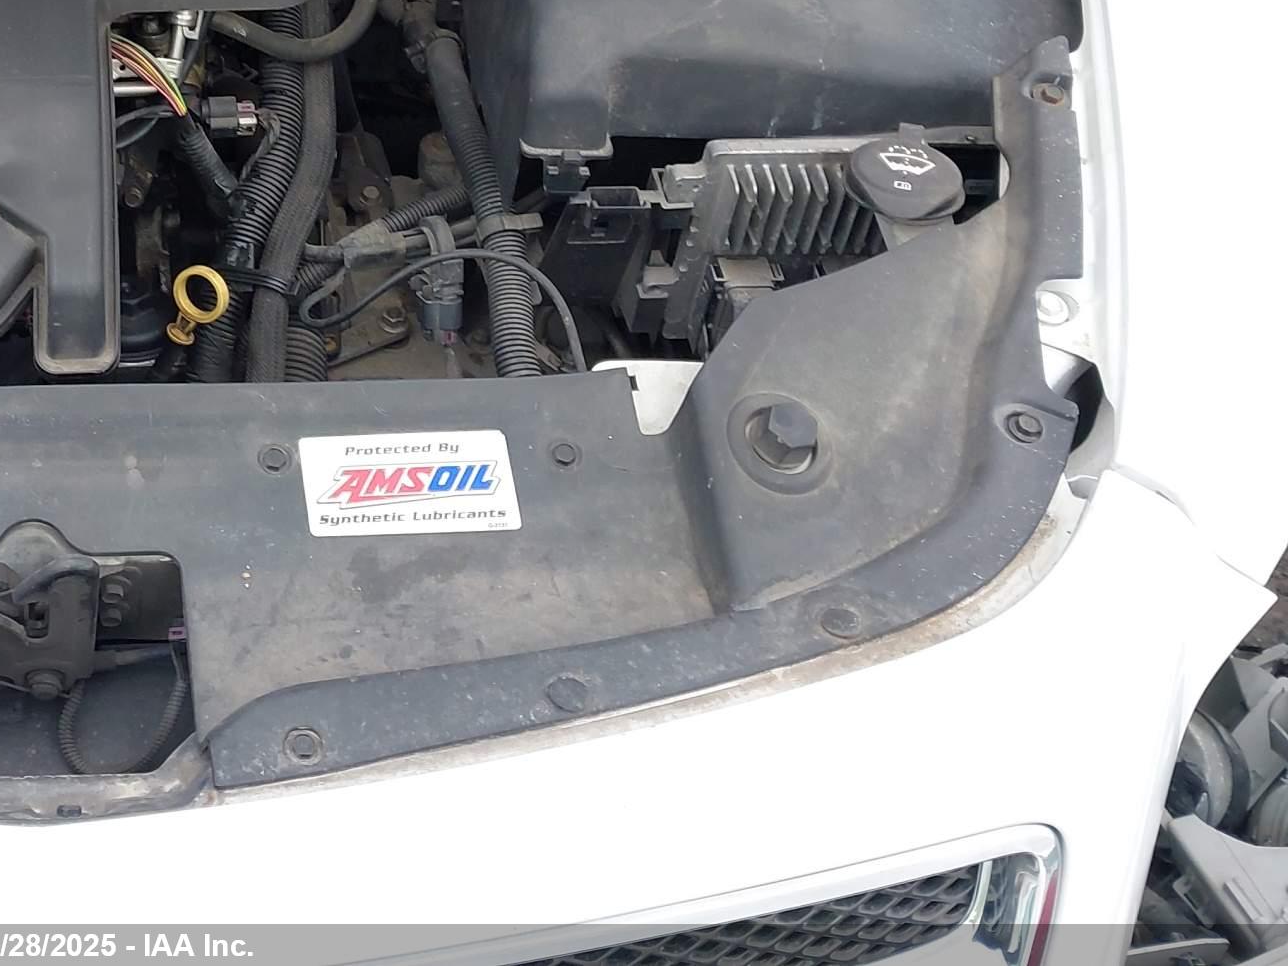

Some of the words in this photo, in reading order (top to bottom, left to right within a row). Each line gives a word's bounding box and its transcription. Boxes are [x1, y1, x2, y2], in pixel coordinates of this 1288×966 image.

[345, 444, 431, 456] Protected
[438, 443, 459, 454] By
[328, 464, 493, 503] AMSOIL
[320, 512, 405, 526] Synthetic
[412, 509, 507, 521] Lubricants
